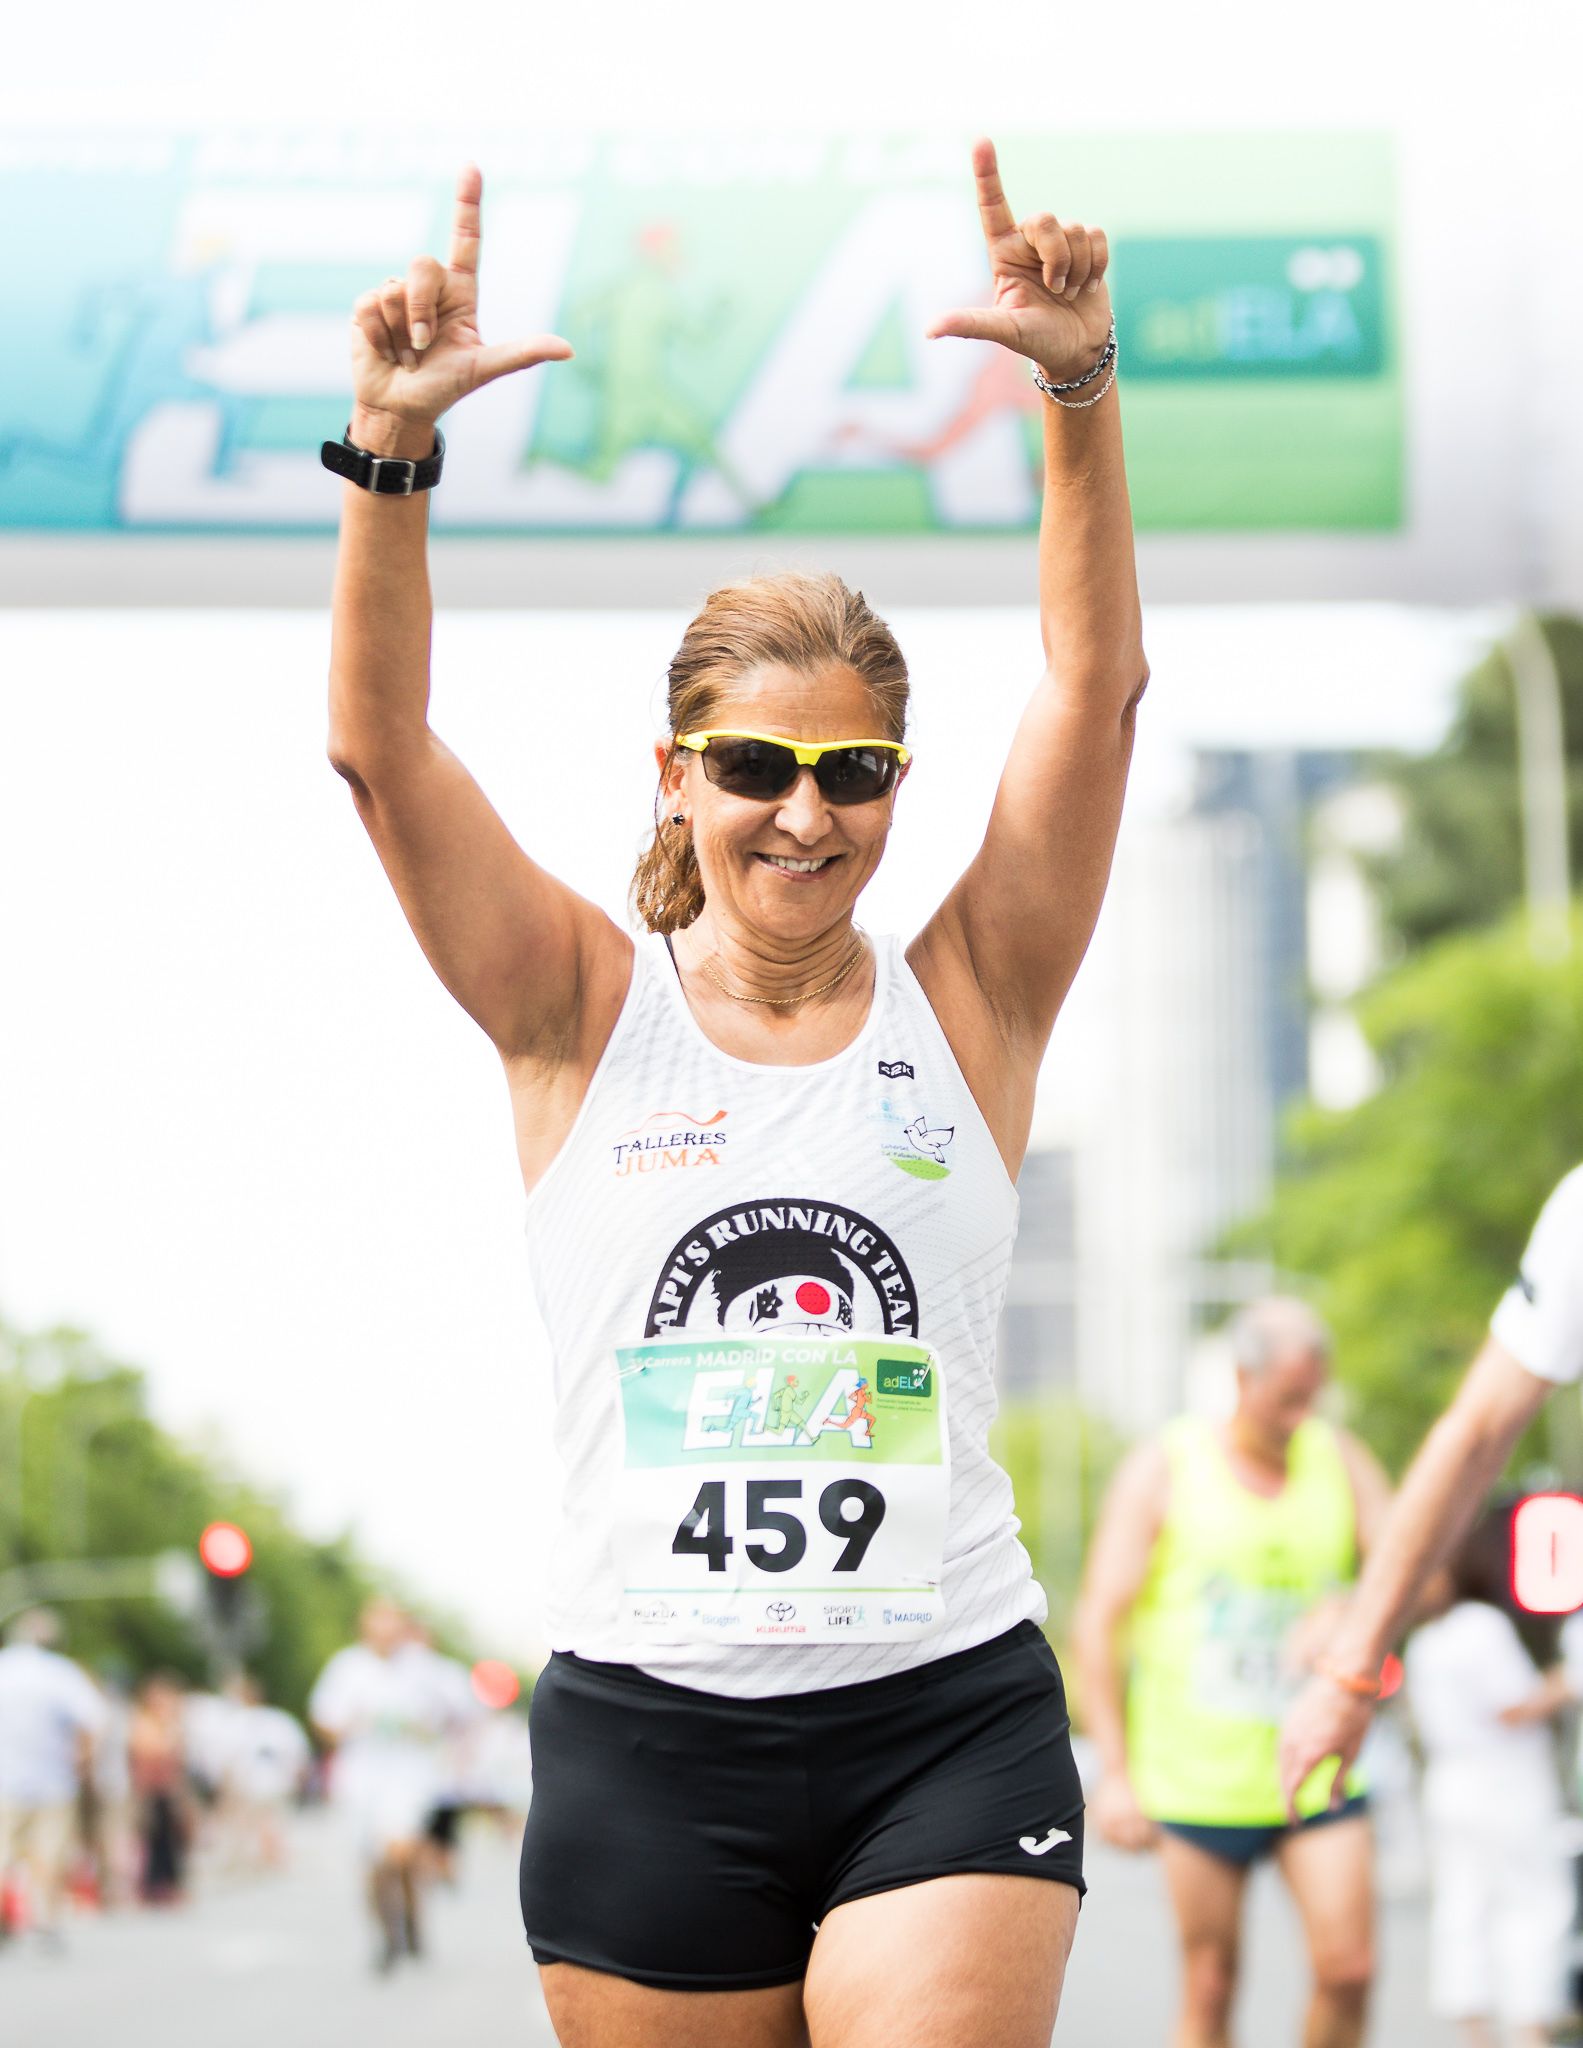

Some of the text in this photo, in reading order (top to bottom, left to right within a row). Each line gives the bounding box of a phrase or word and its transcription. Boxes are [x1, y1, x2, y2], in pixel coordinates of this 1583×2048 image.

[613, 1133, 726, 1164] TALLERES
[615, 1148, 720, 1177] JUMA
[654, 1239, 710, 1337] API'S
[705, 1207, 876, 1256] RUNNING
[696, 1349, 776, 1367] MADRID
[781, 1349, 826, 1365] CON
[832, 1349, 858, 1365] LA
[682, 1367, 873, 1451] ELA
[672, 1479, 886, 1573] 459
[824, 1605, 857, 1615] SPORT
[828, 1616, 854, 1626] LIFE
[894, 1612, 932, 1624] MADRID
